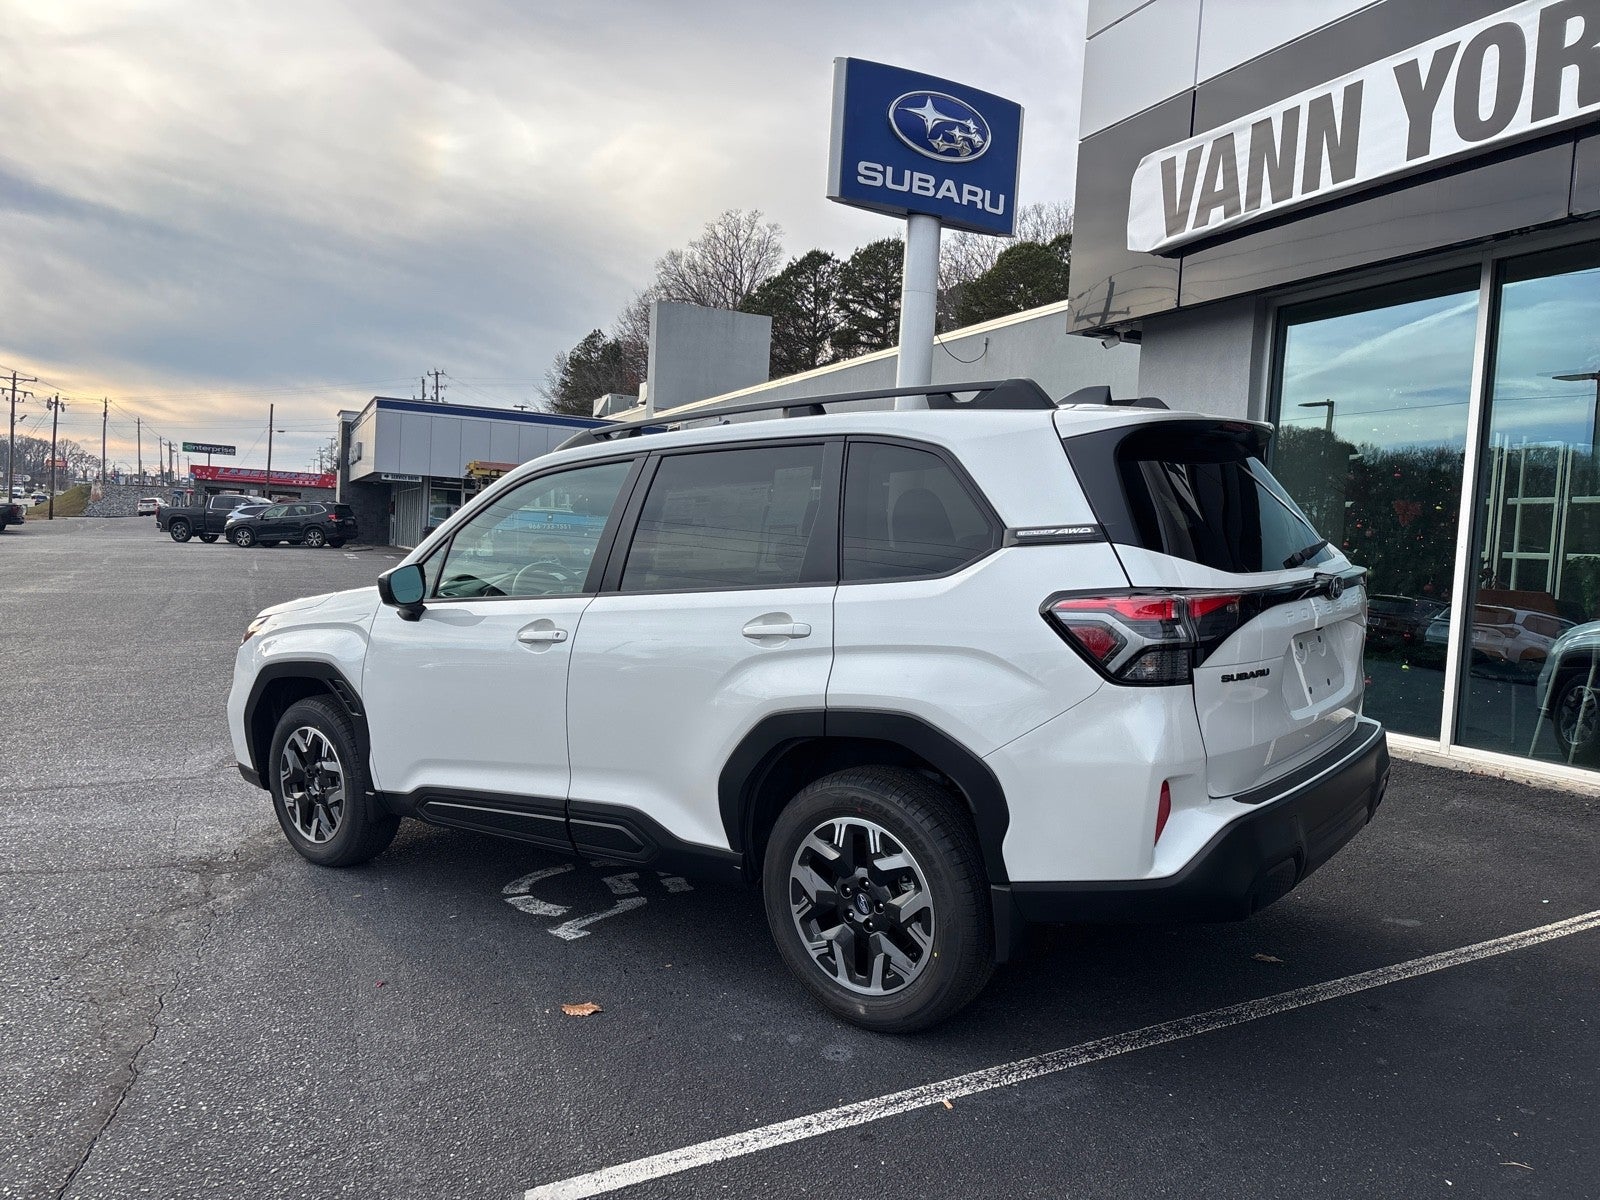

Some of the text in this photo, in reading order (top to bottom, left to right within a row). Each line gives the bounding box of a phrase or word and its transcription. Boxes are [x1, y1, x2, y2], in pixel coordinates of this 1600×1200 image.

[1160, 79, 1364, 239] VANN
[857, 160, 1005, 216] SUBARU
[186, 444, 235, 454] enterprise
[1055, 526, 1092, 535] AWD
[1220, 668, 1270, 683] SUBARU
